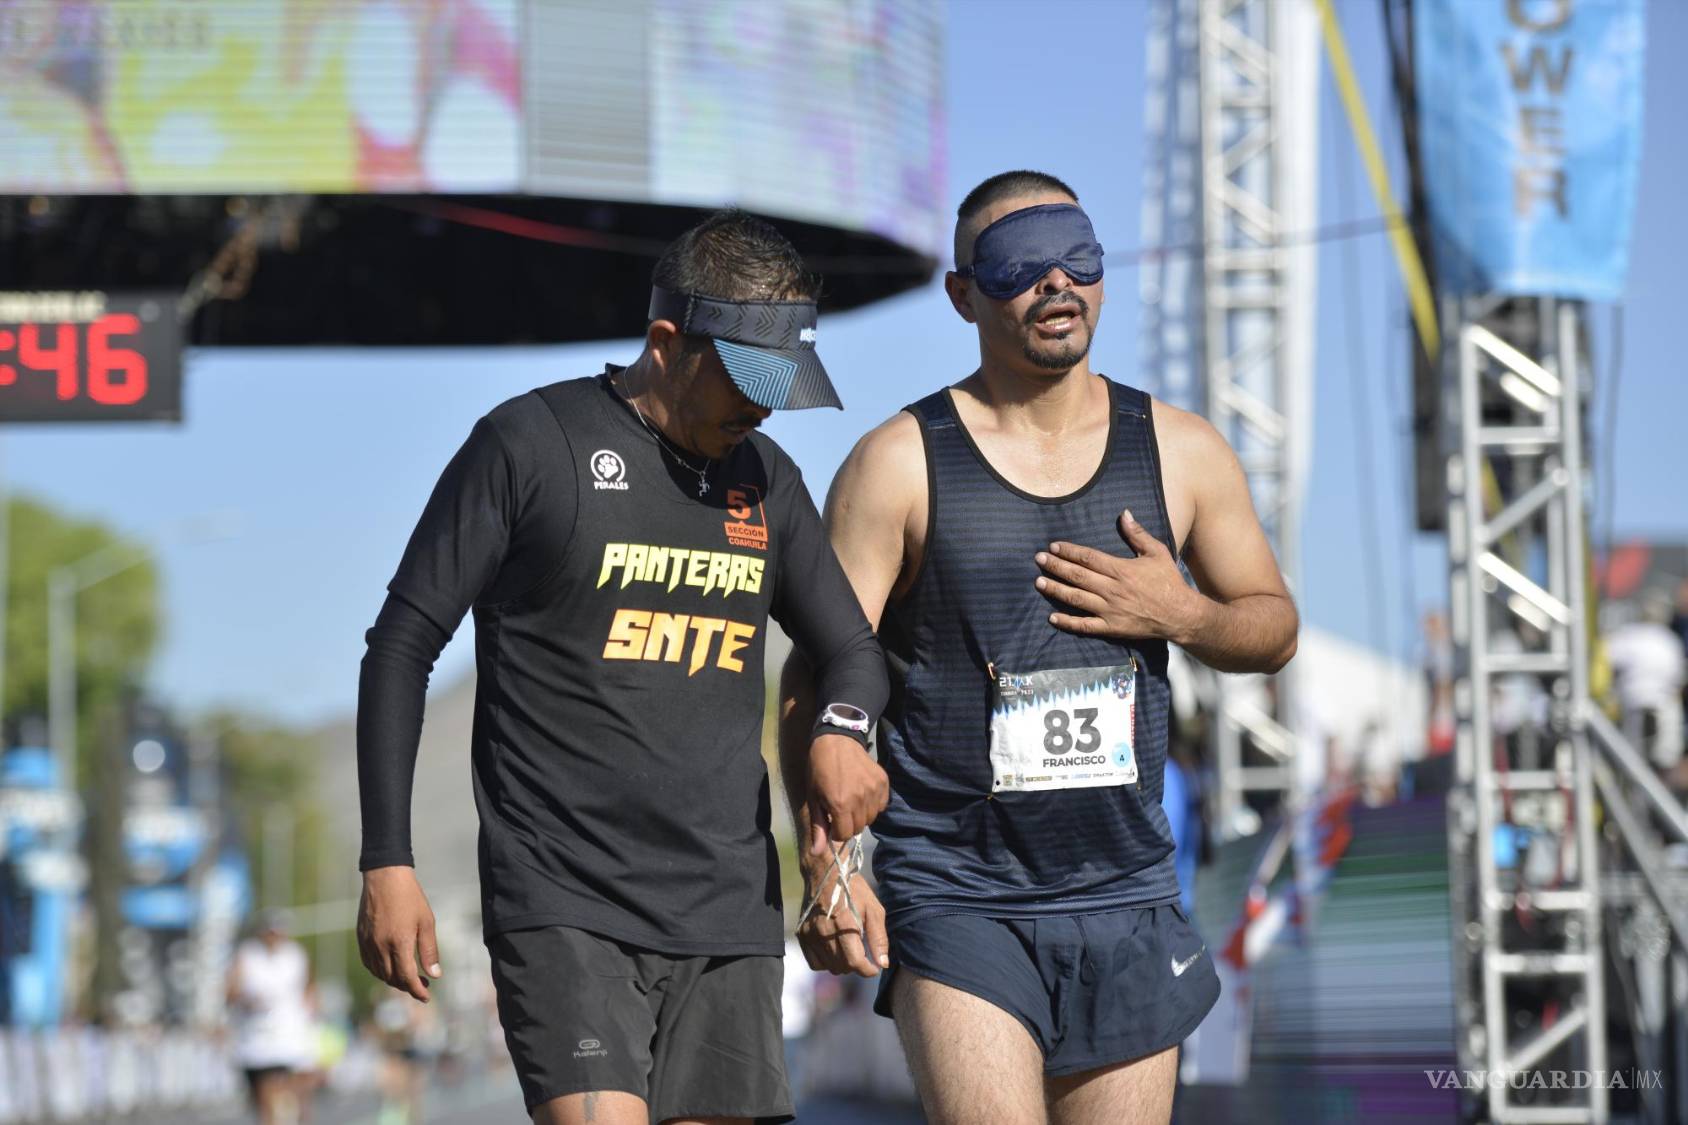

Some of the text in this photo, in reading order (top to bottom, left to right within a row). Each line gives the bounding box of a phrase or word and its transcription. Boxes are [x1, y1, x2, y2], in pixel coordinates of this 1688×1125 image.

[594, 481, 629, 490] PERALES
[728, 489, 752, 520] 5
[729, 537, 768, 550] COAHUILA
[596, 543, 765, 599] PANTERAS
[602, 609, 756, 678] SNTE
[1043, 708, 1102, 755] 83
[1042, 755, 1106, 768] FRANCISCO
